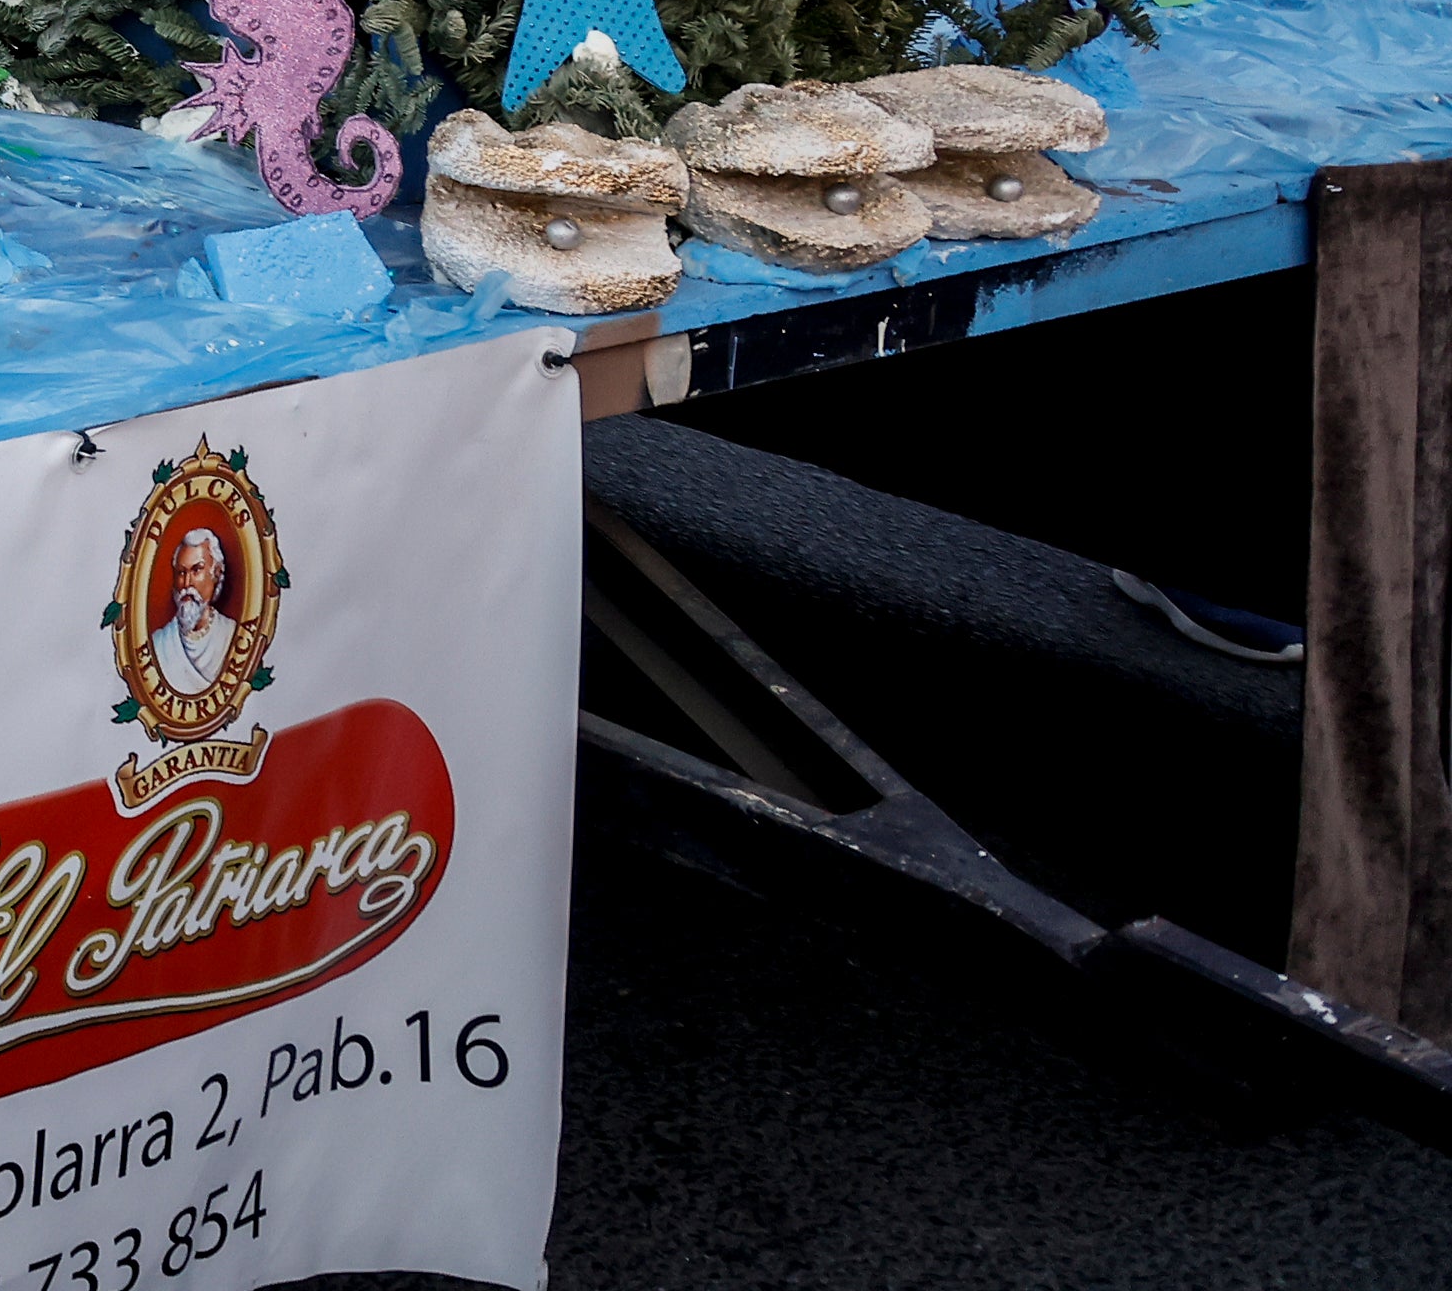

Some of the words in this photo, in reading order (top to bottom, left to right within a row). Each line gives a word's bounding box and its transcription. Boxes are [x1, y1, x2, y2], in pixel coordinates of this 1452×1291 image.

[146, 477, 252, 543] DULCES
[134, 638, 152, 682] EL
[150, 615, 260, 723] PATRIARCA
[132, 745, 248, 800] GARANTIA
[63, 795, 438, 996] Patriarca
[195, 1072, 246, 1156] 2,
[160, 1169, 269, 1279] 854
